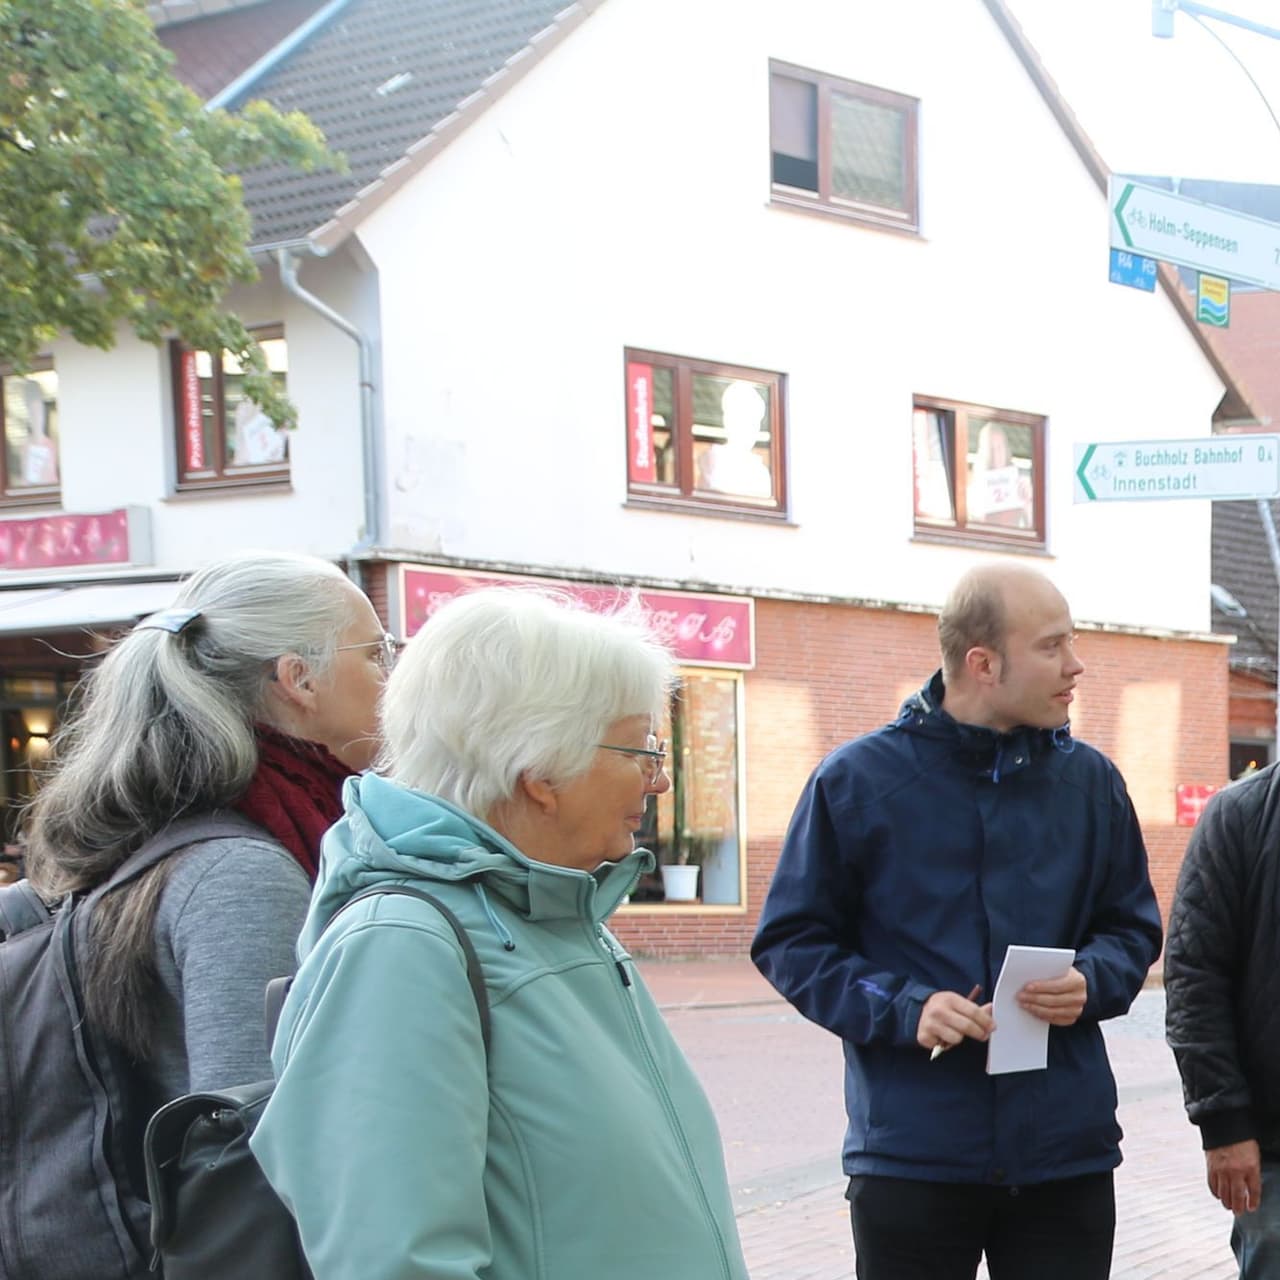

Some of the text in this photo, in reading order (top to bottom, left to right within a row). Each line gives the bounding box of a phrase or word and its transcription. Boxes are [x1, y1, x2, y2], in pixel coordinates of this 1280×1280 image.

[1149, 212, 1239, 253] Holm-Seppensen
[633, 376, 648, 468] Studienkreis
[1135, 449, 1189, 467] Buchholz
[1194, 446, 1244, 465] Bahnhof
[1112, 474, 1198, 492] Innenstadt
